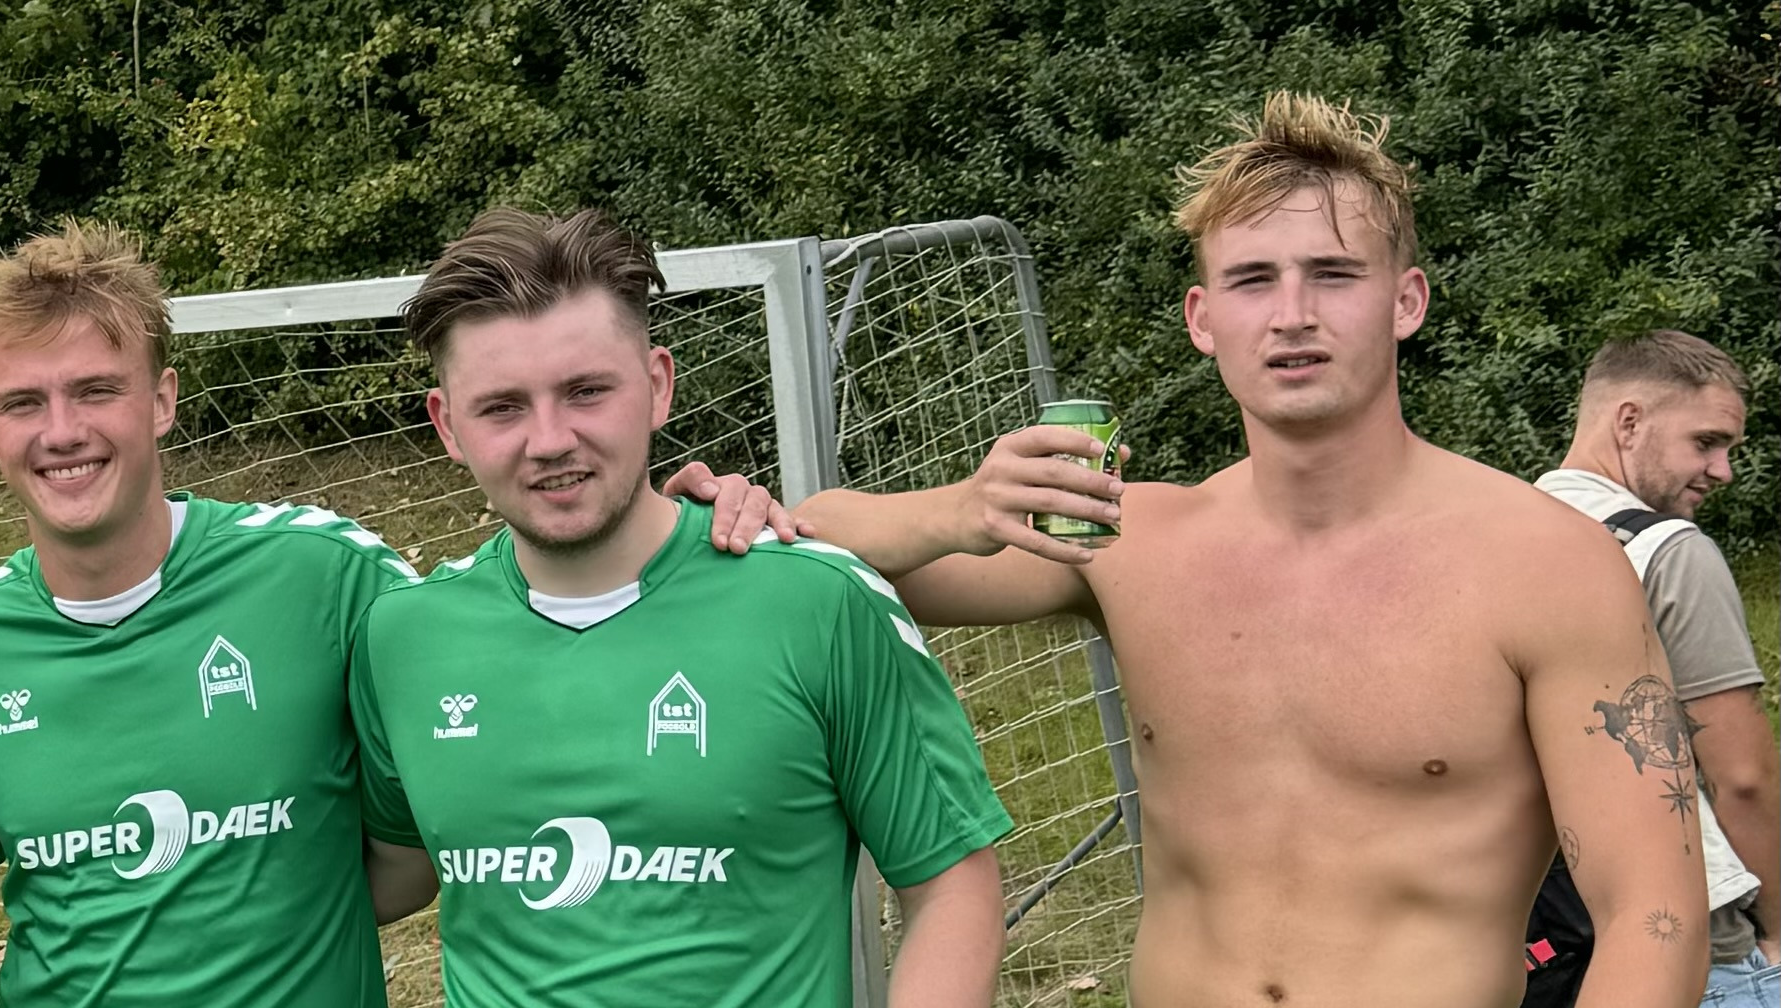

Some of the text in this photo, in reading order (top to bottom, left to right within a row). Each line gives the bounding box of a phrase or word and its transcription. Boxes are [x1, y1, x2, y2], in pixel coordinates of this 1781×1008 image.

[663, 703, 693, 717] tst
[17, 796, 295, 870] SUPER DAEK
[438, 845, 735, 884] SUPER DAEK
